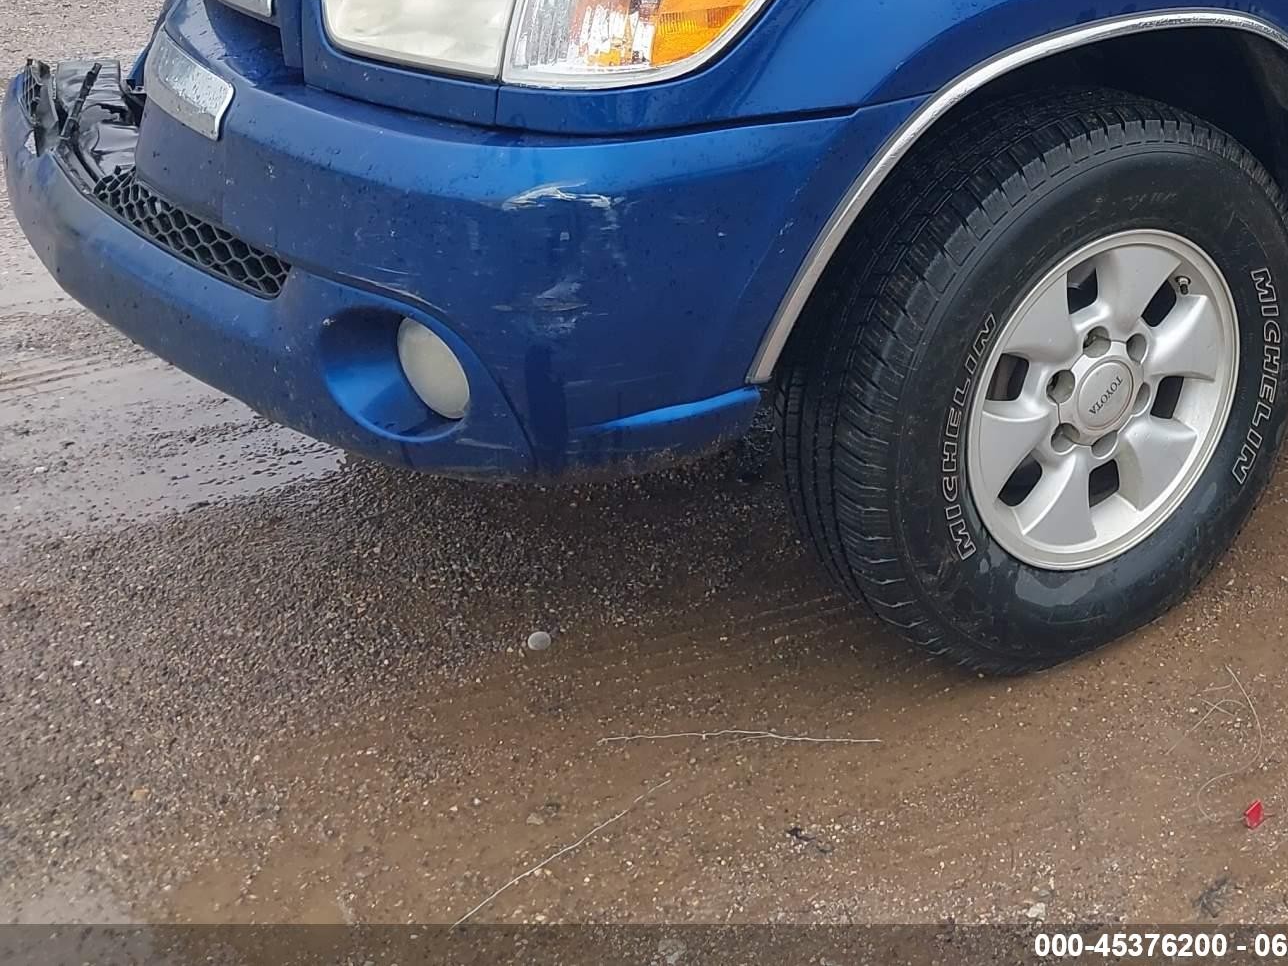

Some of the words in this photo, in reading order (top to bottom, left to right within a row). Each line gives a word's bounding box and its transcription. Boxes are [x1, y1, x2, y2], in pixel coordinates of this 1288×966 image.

[941, 313, 997, 561] MICHELIN
[1088, 375, 1124, 415] TOYOTA
[1231, 268, 1282, 485] MICHELIN
